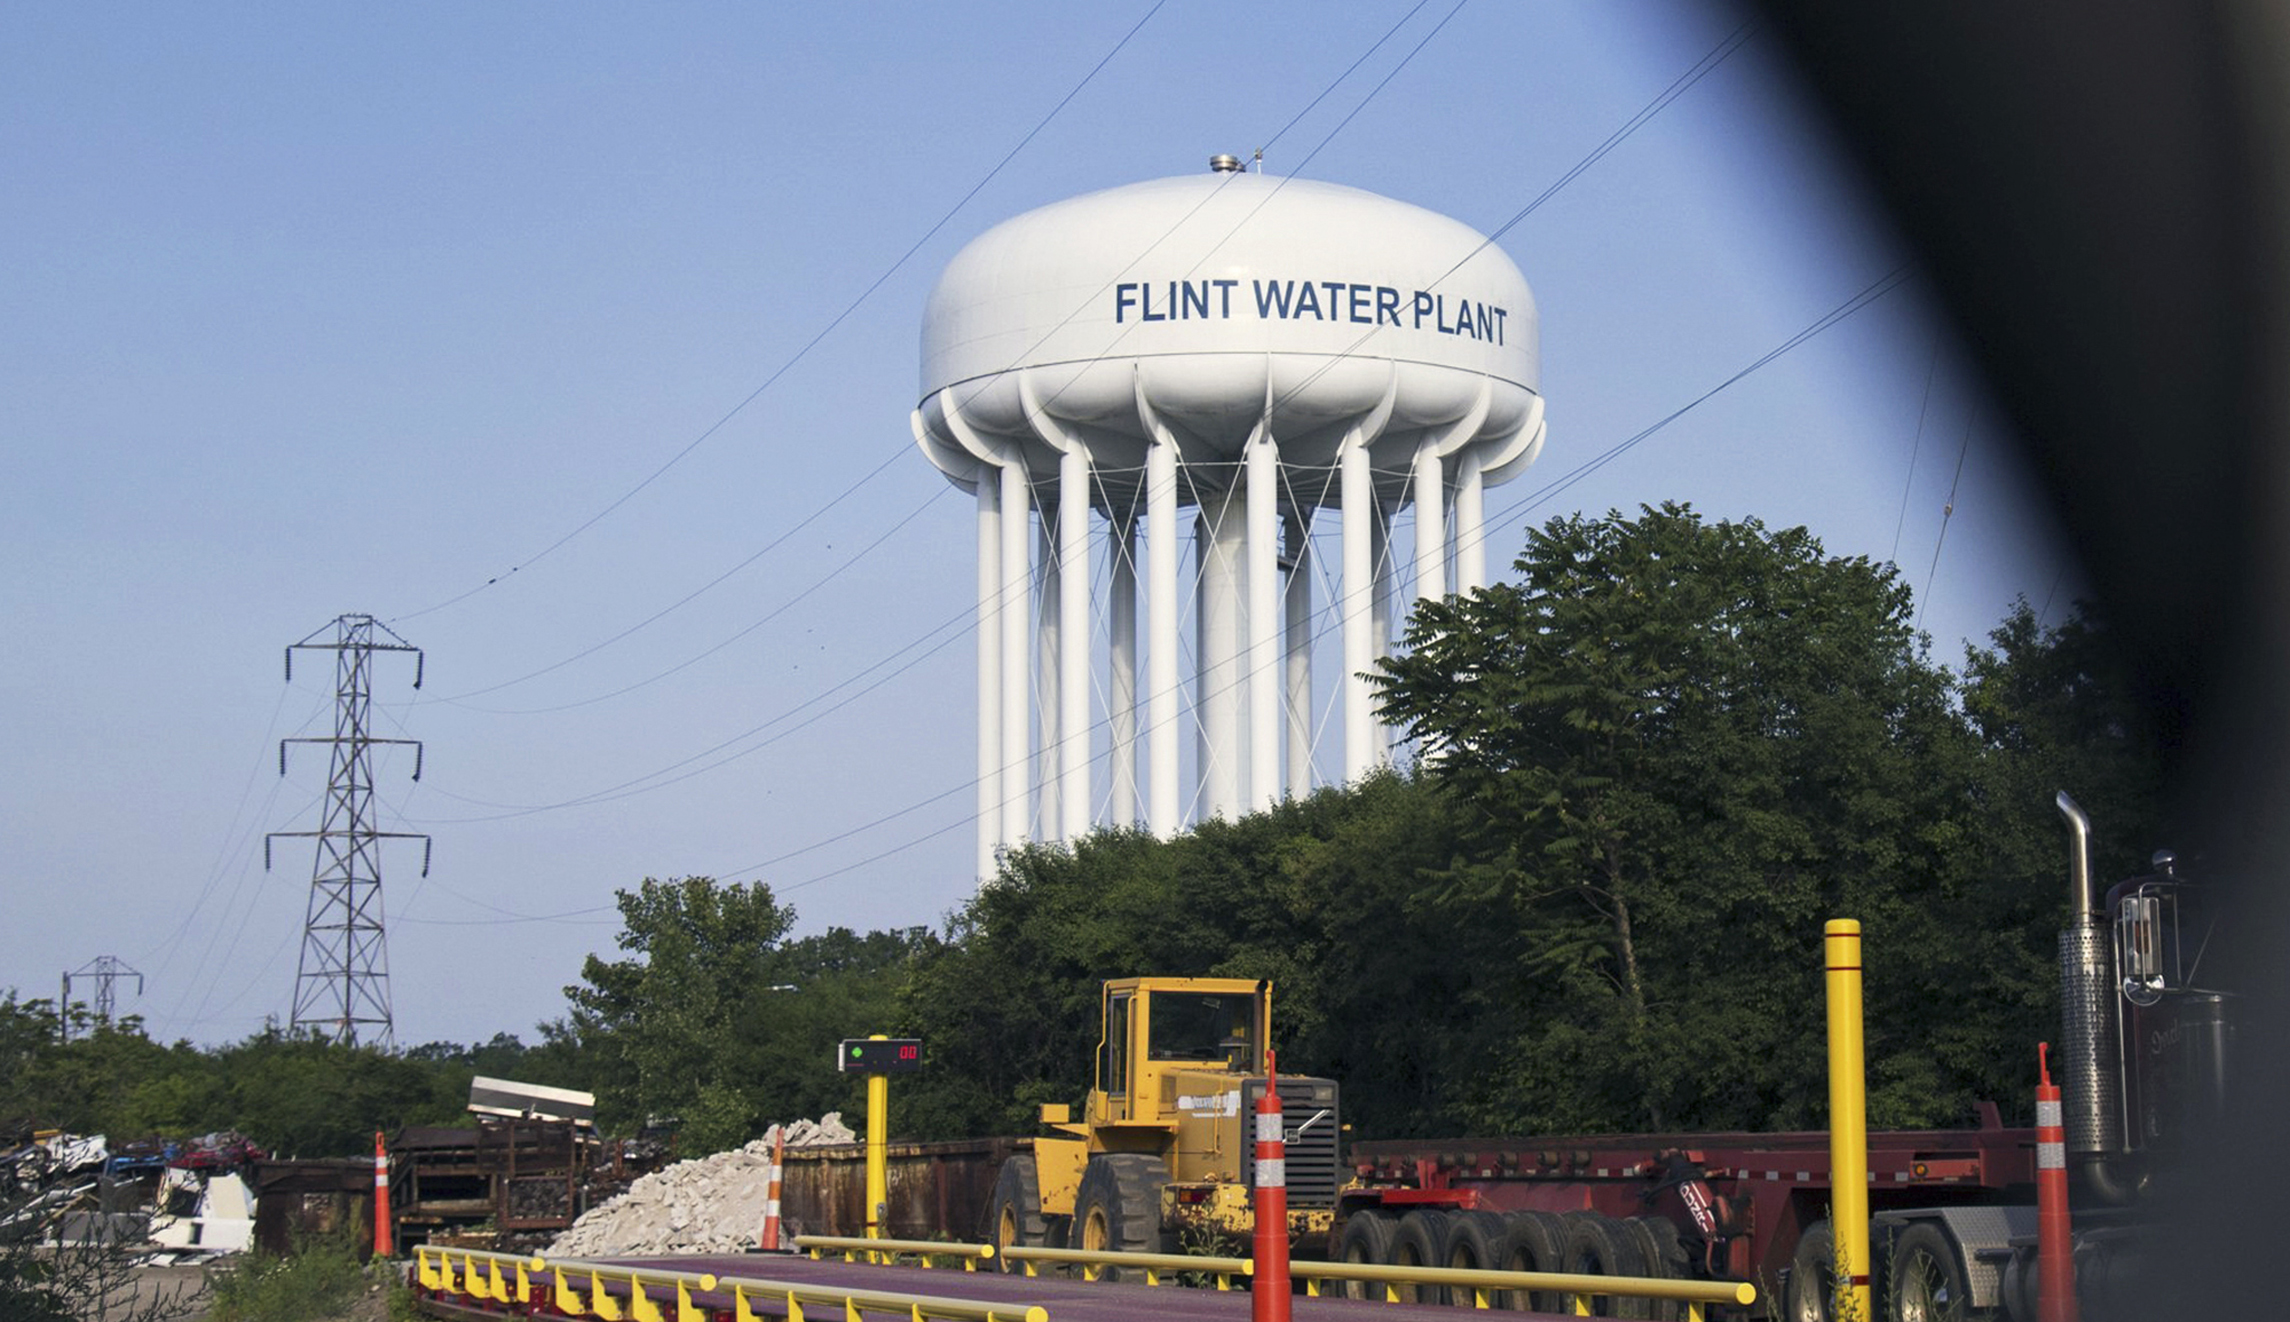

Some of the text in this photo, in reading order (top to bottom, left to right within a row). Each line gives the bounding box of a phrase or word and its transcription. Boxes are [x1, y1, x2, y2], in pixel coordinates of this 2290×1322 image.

[1116, 279, 1508, 347] FLINT WATER PLANT
